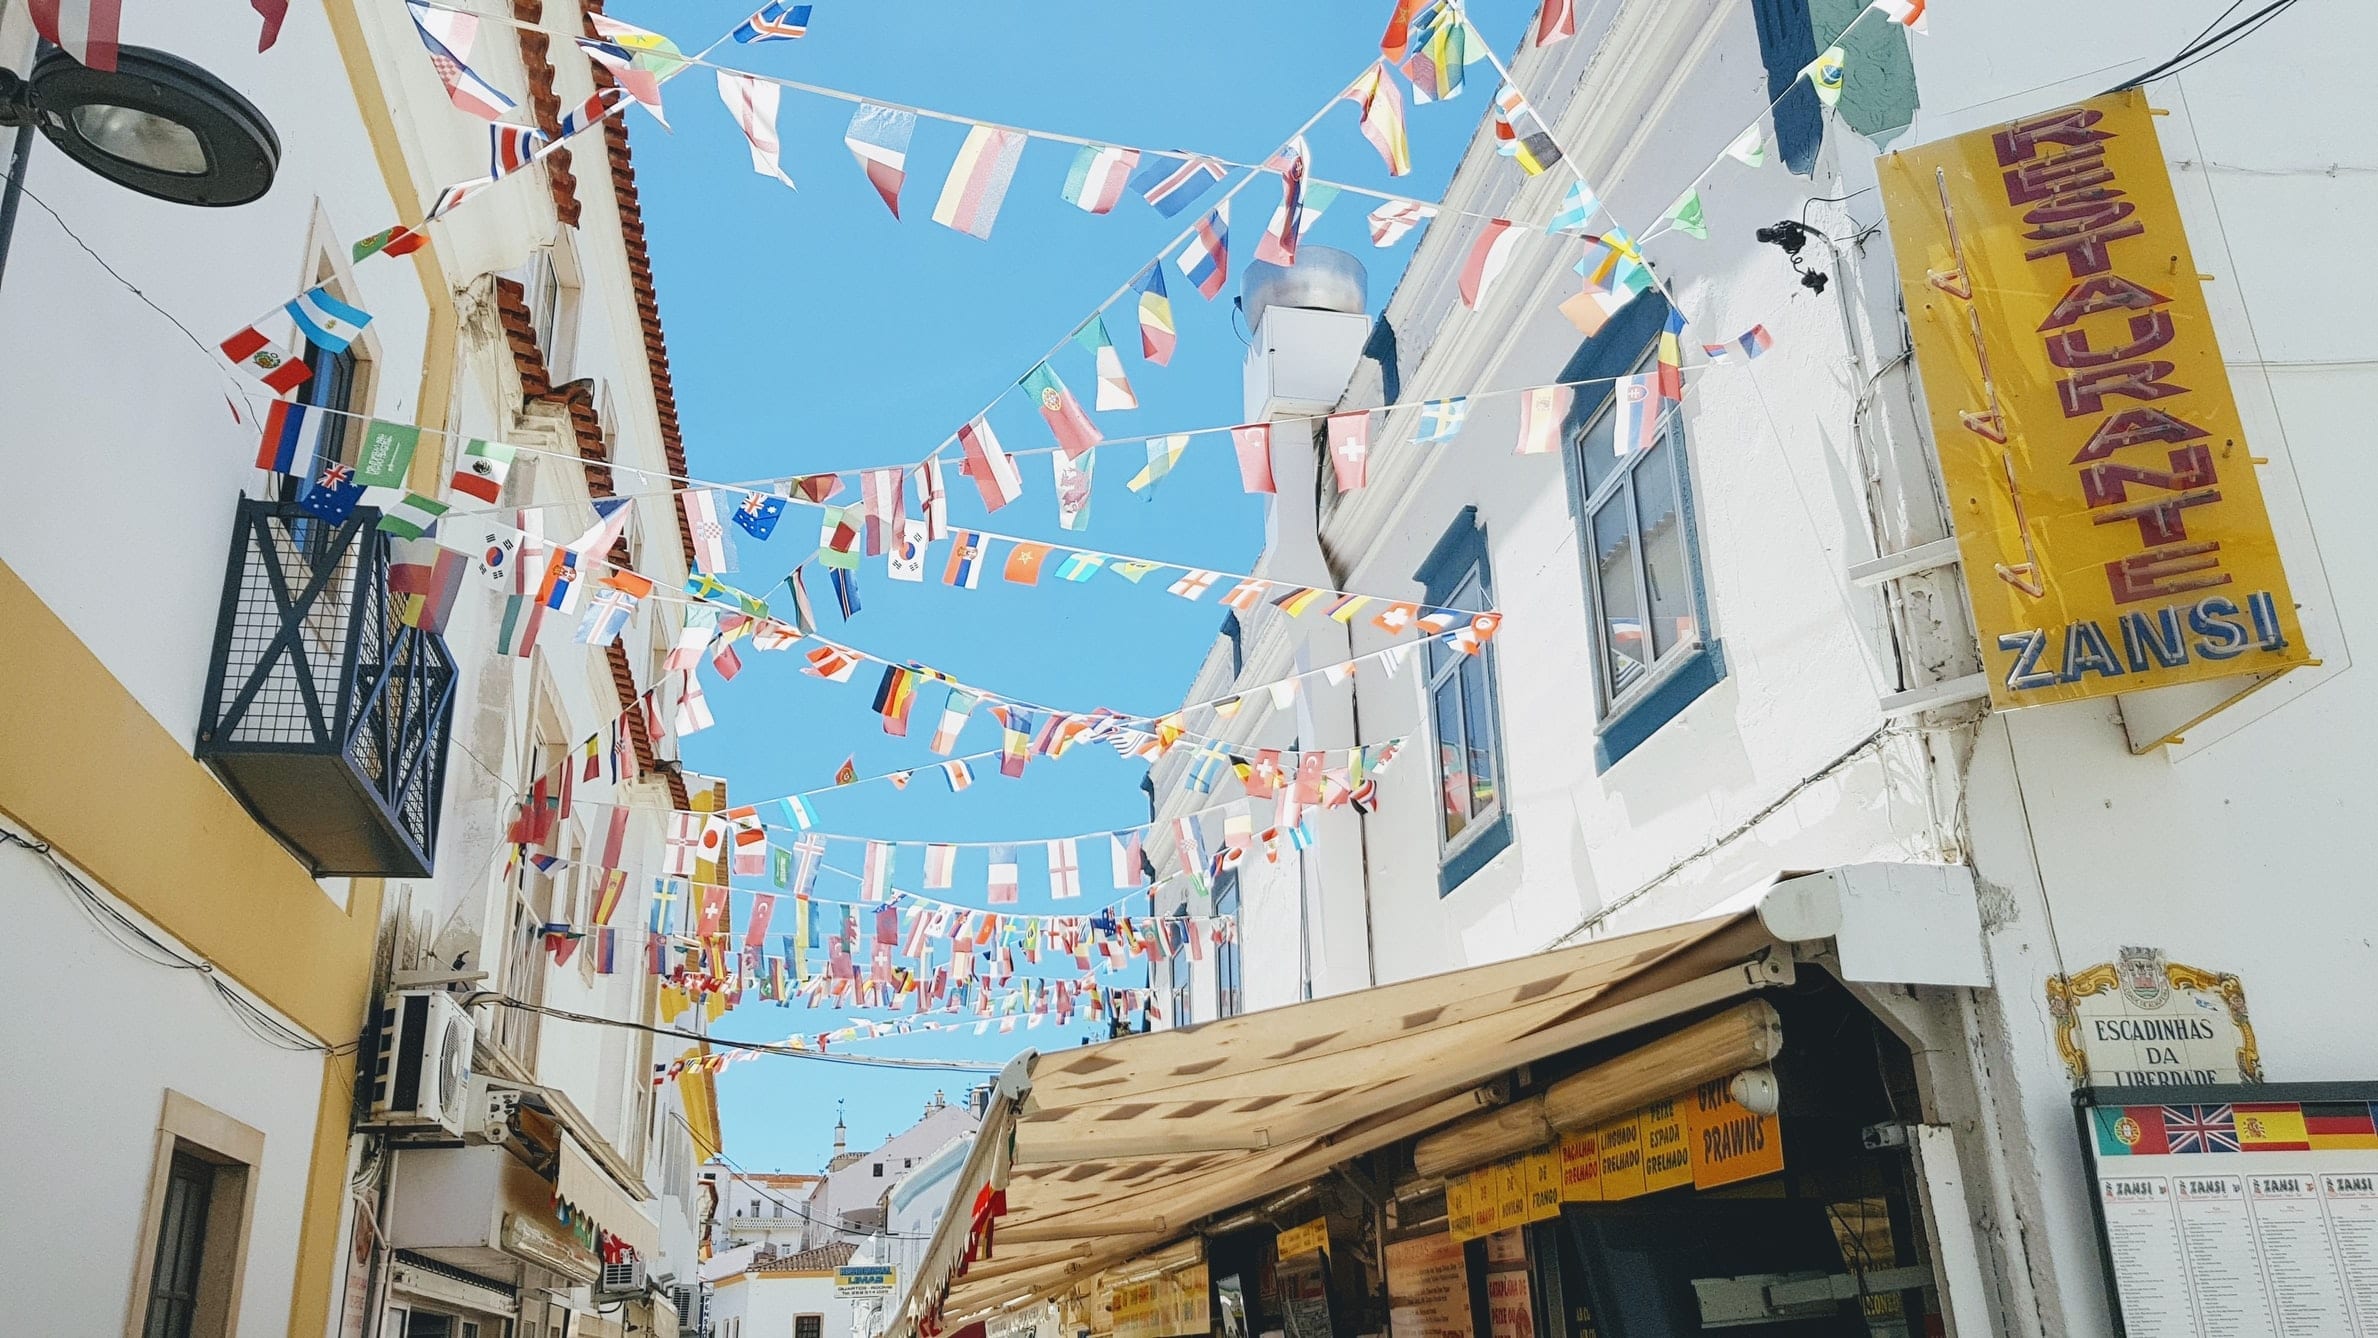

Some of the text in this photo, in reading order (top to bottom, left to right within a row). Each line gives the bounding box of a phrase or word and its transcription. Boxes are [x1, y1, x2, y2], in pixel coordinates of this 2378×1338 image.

[1992, 109, 2233, 605] RESTAURANTE
[1998, 589, 2288, 692] ZANSI
[2095, 1018, 2214, 1041] ESCADINHAS
[2146, 1047, 2180, 1065] DA
[1600, 1125, 1637, 1151] LINGUADO
[1649, 1124, 1680, 1149] ESPADA
[1703, 1114, 1766, 1165] PRAWNS
[1564, 1161, 1598, 1185] GRELHADO
[1602, 1148, 1640, 1175] GRELHADO
[1646, 1147, 1688, 1176] GRELHADO
[1538, 1165, 1547, 1182] DE
[2336, 1177, 2374, 1192] ZANSI
[2116, 1182, 2152, 1196] ZANSI
[2190, 1180, 2226, 1194] ZANSI
[2263, 1179, 2300, 1193] ZANSI
[1532, 1187, 1558, 1209] FRANGO
